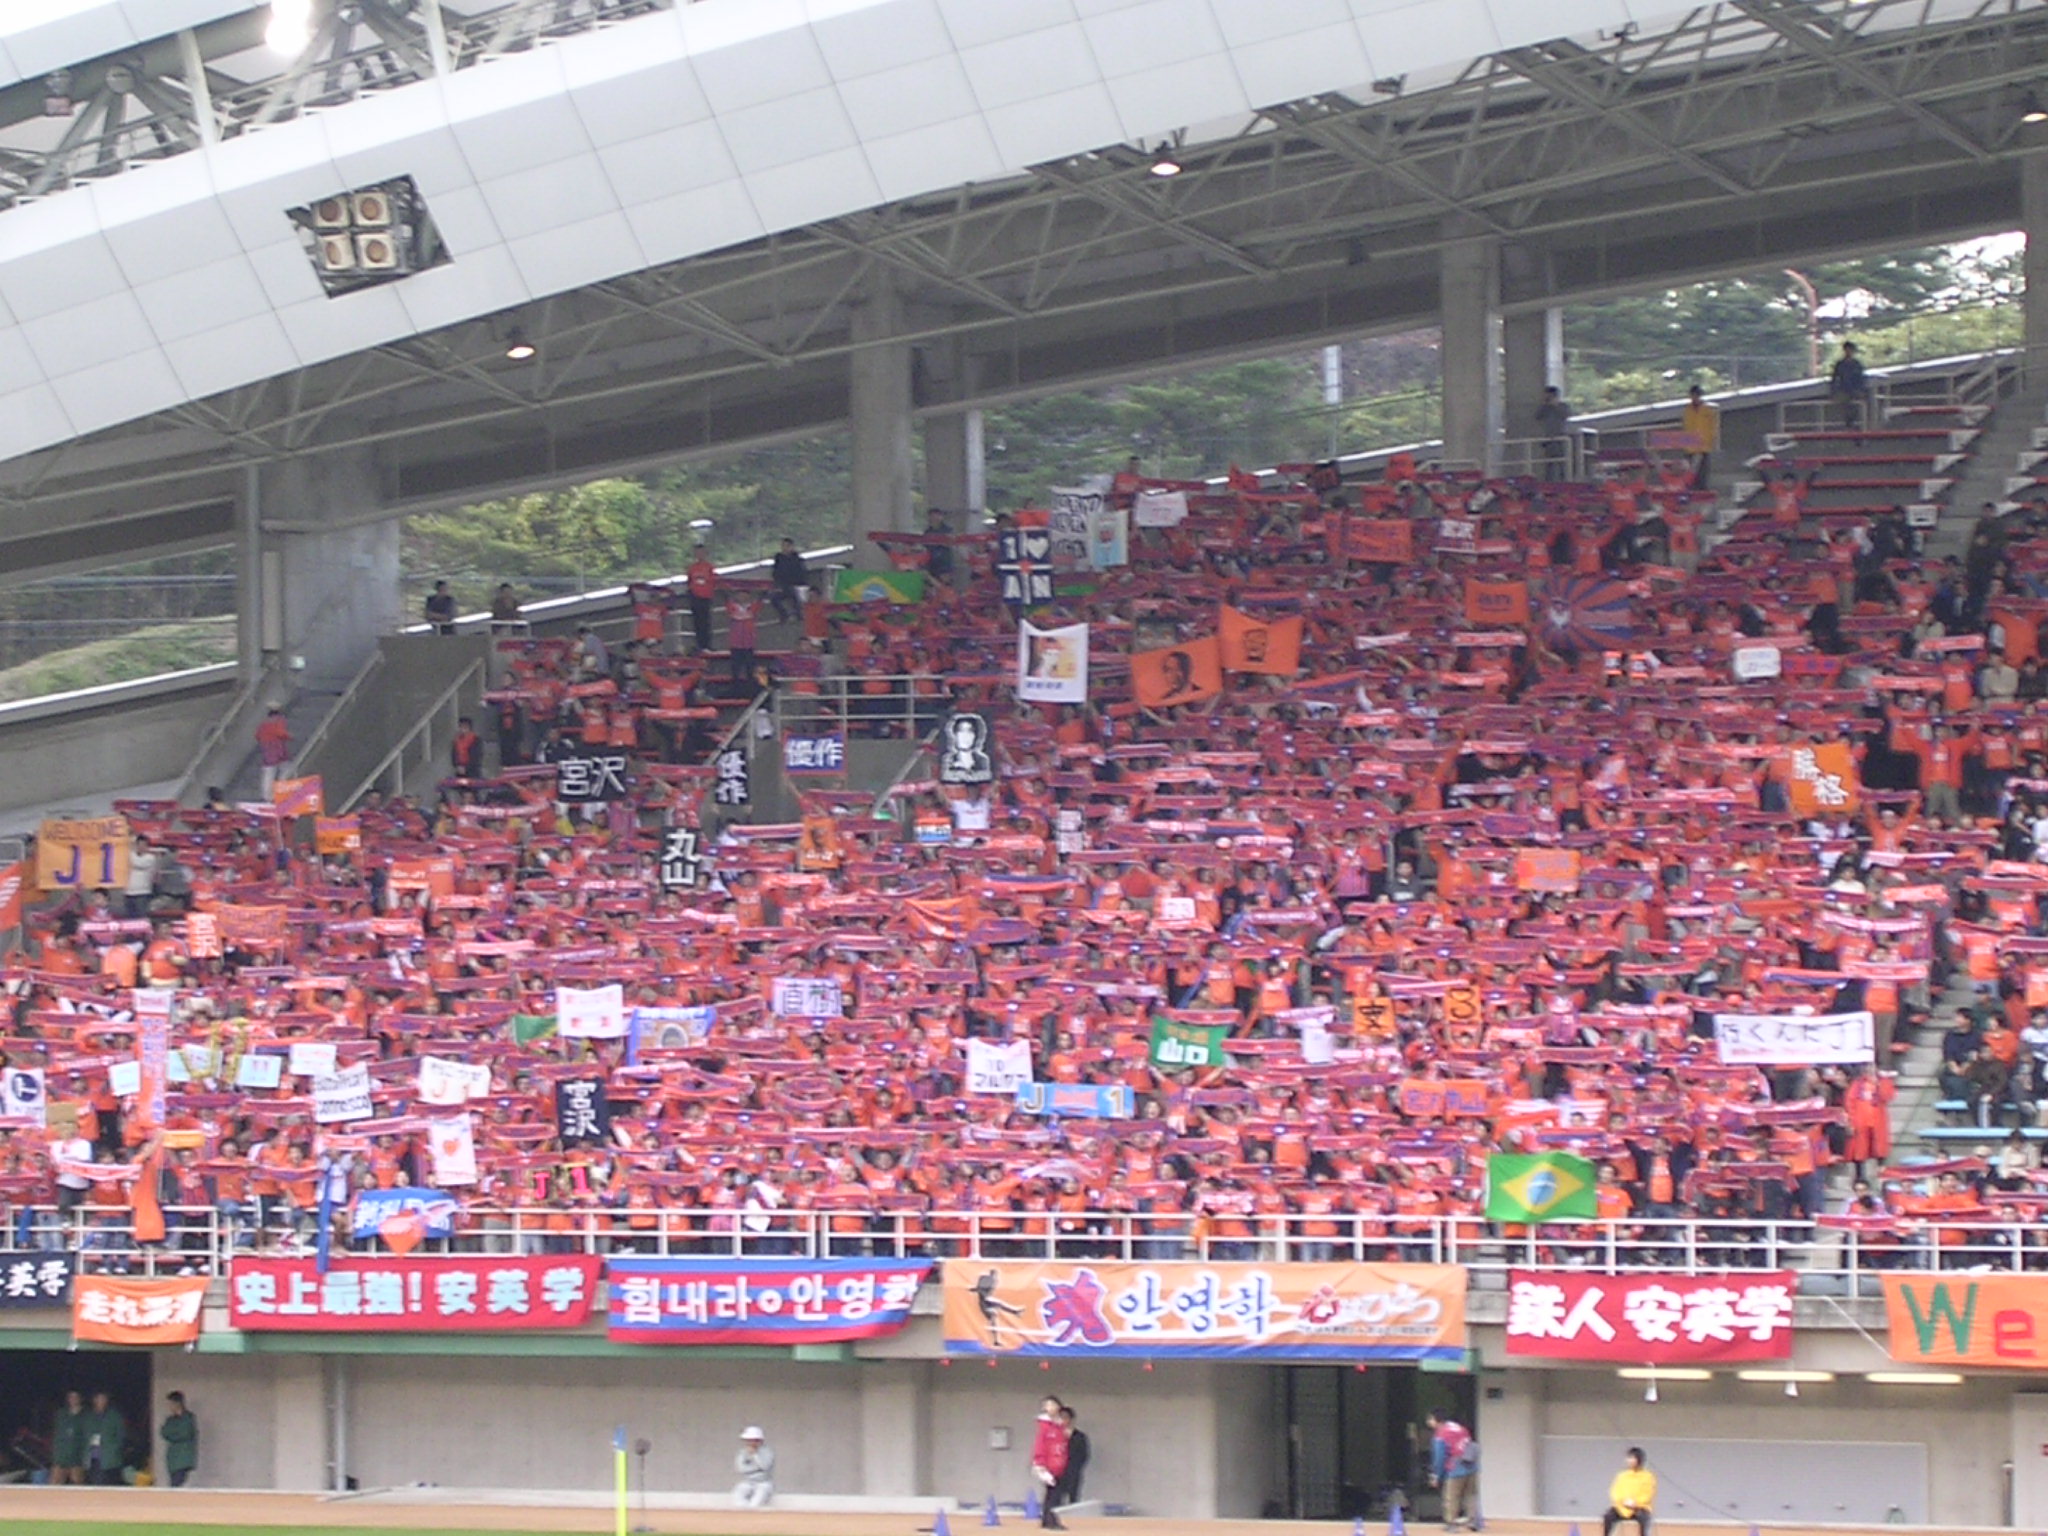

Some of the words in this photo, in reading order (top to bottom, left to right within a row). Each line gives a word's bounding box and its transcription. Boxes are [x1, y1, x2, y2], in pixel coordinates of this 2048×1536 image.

[558, 755, 627, 796] 宮沢
[661, 828, 701, 885] 丸山
[1157, 1036, 1209, 1065] 山口
[562, 1080, 602, 1140] 宮沢
[0, 1260, 70, 1297] 英学
[434, 1268, 585, 1314] 安英学
[619, 1276, 752, 1324] 힘내라
[1117, 1274, 1274, 1336] 안영학
[1507, 1281, 1616, 1341] 鉄人
[1624, 1283, 1793, 1342] 安英学
[1900, 1281, 2036, 1359] We
